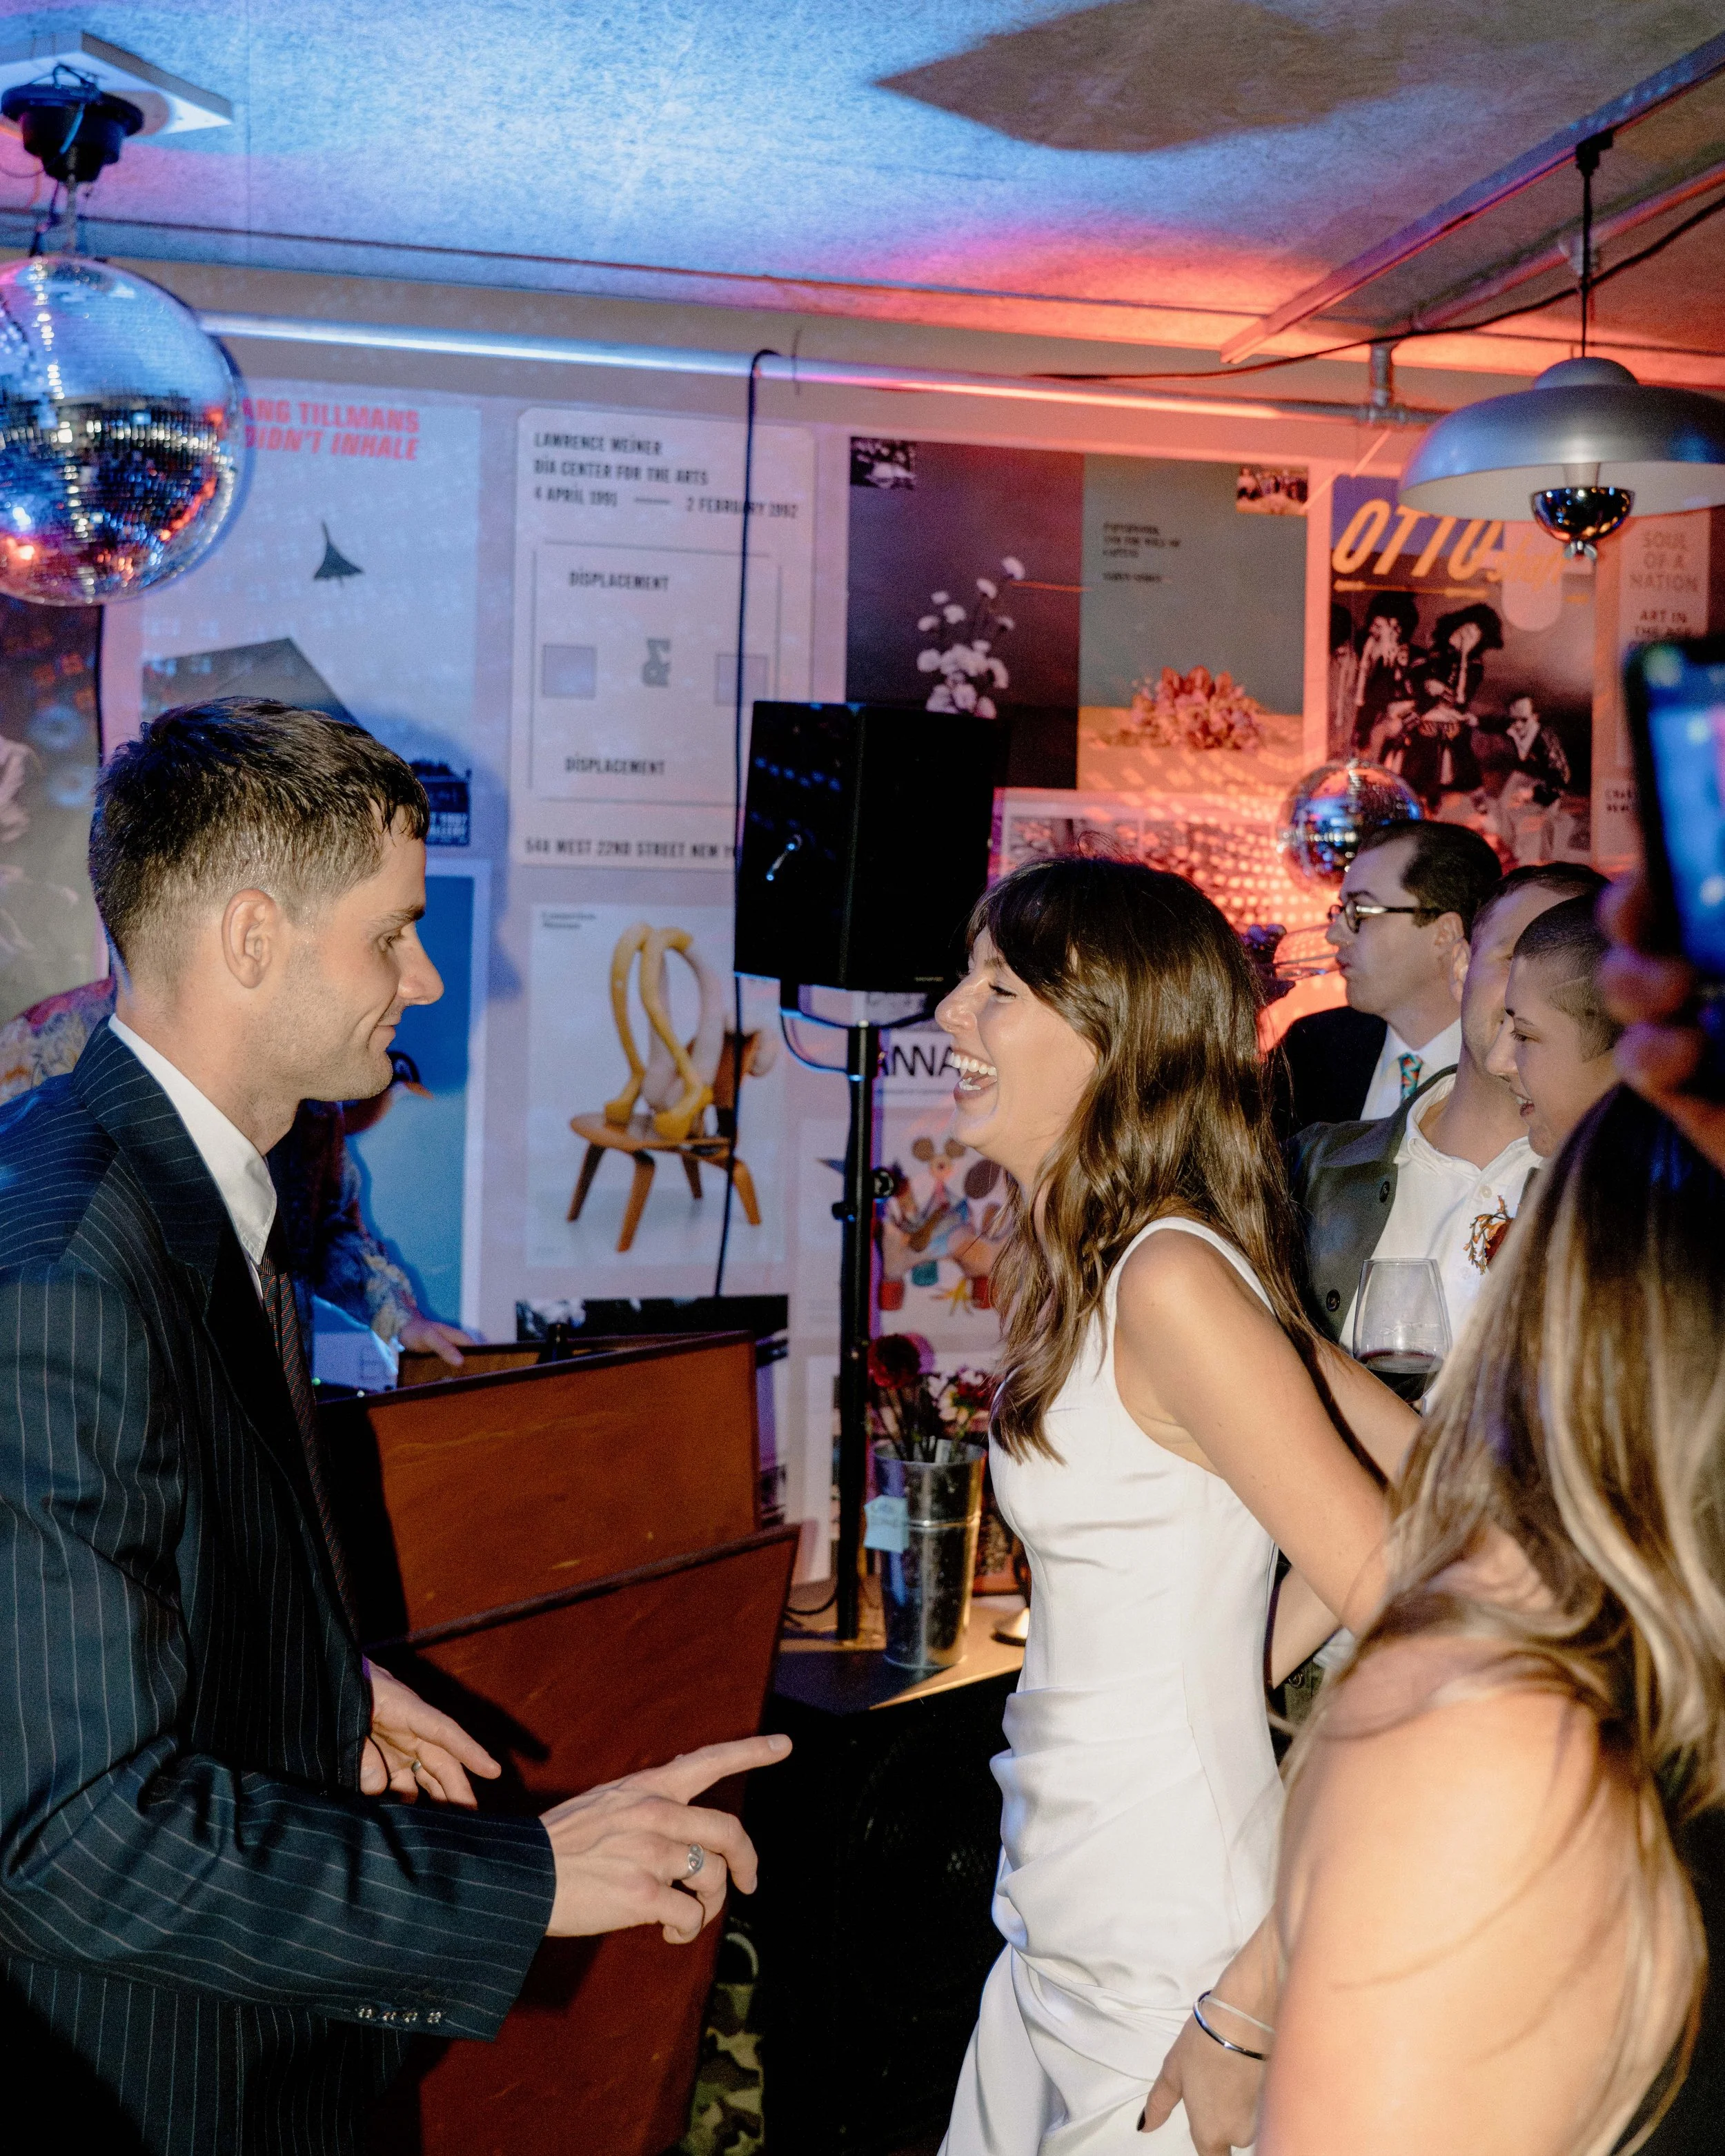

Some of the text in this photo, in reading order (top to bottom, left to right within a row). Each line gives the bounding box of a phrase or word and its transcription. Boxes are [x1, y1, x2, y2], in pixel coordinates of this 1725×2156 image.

[299, 401, 420, 433] TILLMANS
[331, 433, 420, 460] INHALE
[534, 433, 662, 455] LAWRENCE WEINER
[561, 461, 612, 479] CENTER
[616, 464, 641, 481] FOR
[647, 466, 669, 483] THE
[676, 469, 709, 486] ARTS
[547, 487, 584, 505] APRIL
[699, 498, 765, 515] FEBRURY
[569, 570, 669, 591] DISPLACEMENT
[1630, 573, 1699, 592] NATION
[1639, 610, 1666, 621] ART
[565, 756, 665, 776] DISPLACEMENT
[555, 838, 592, 856] WEST
[635, 840, 685, 858] STREET
[691, 842, 718, 859] NEW
